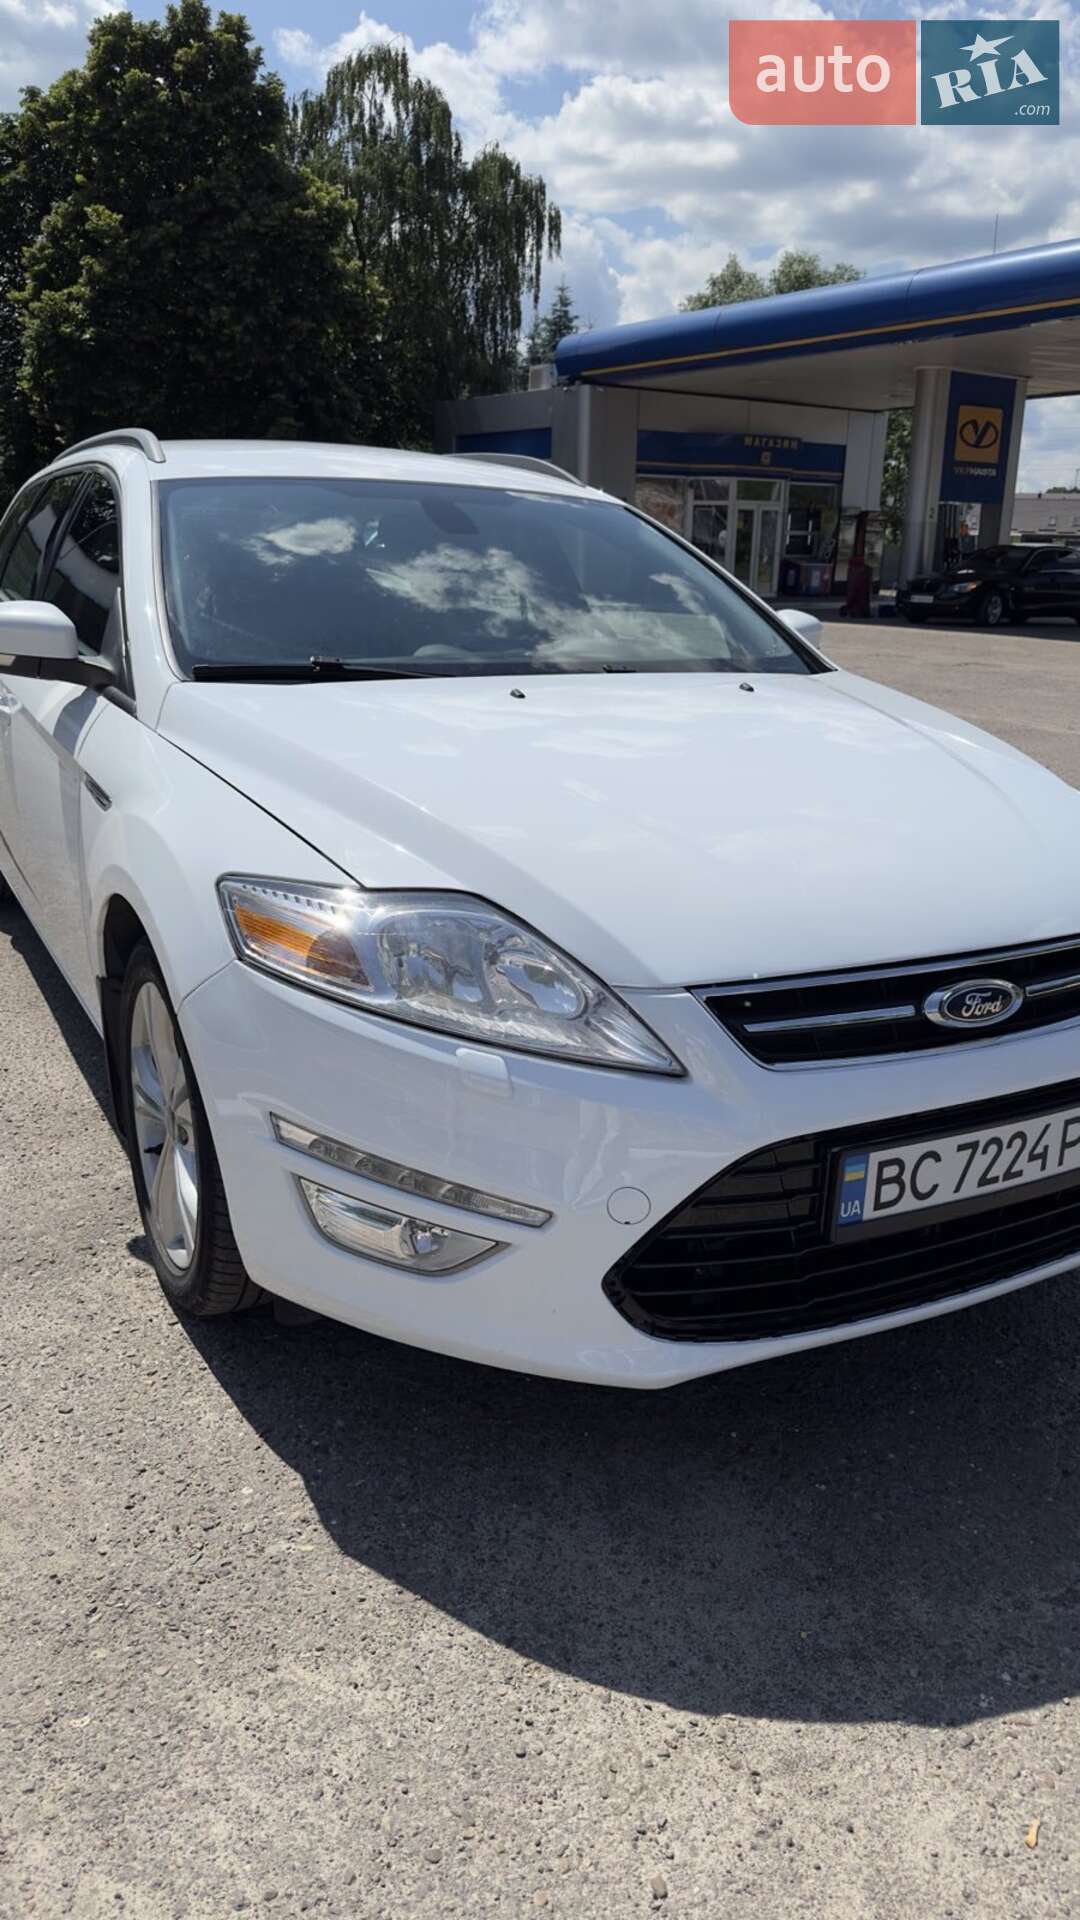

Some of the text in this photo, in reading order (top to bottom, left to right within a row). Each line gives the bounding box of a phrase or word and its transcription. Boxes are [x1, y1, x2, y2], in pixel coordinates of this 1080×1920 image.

[744, 436, 798, 449] МАГАЗИН
[962, 992, 1003, 1017] Ford
[873, 1151, 941, 1211] BC
[954, 1123, 1051, 1193] 7224
[841, 1200, 861, 1218] UA
